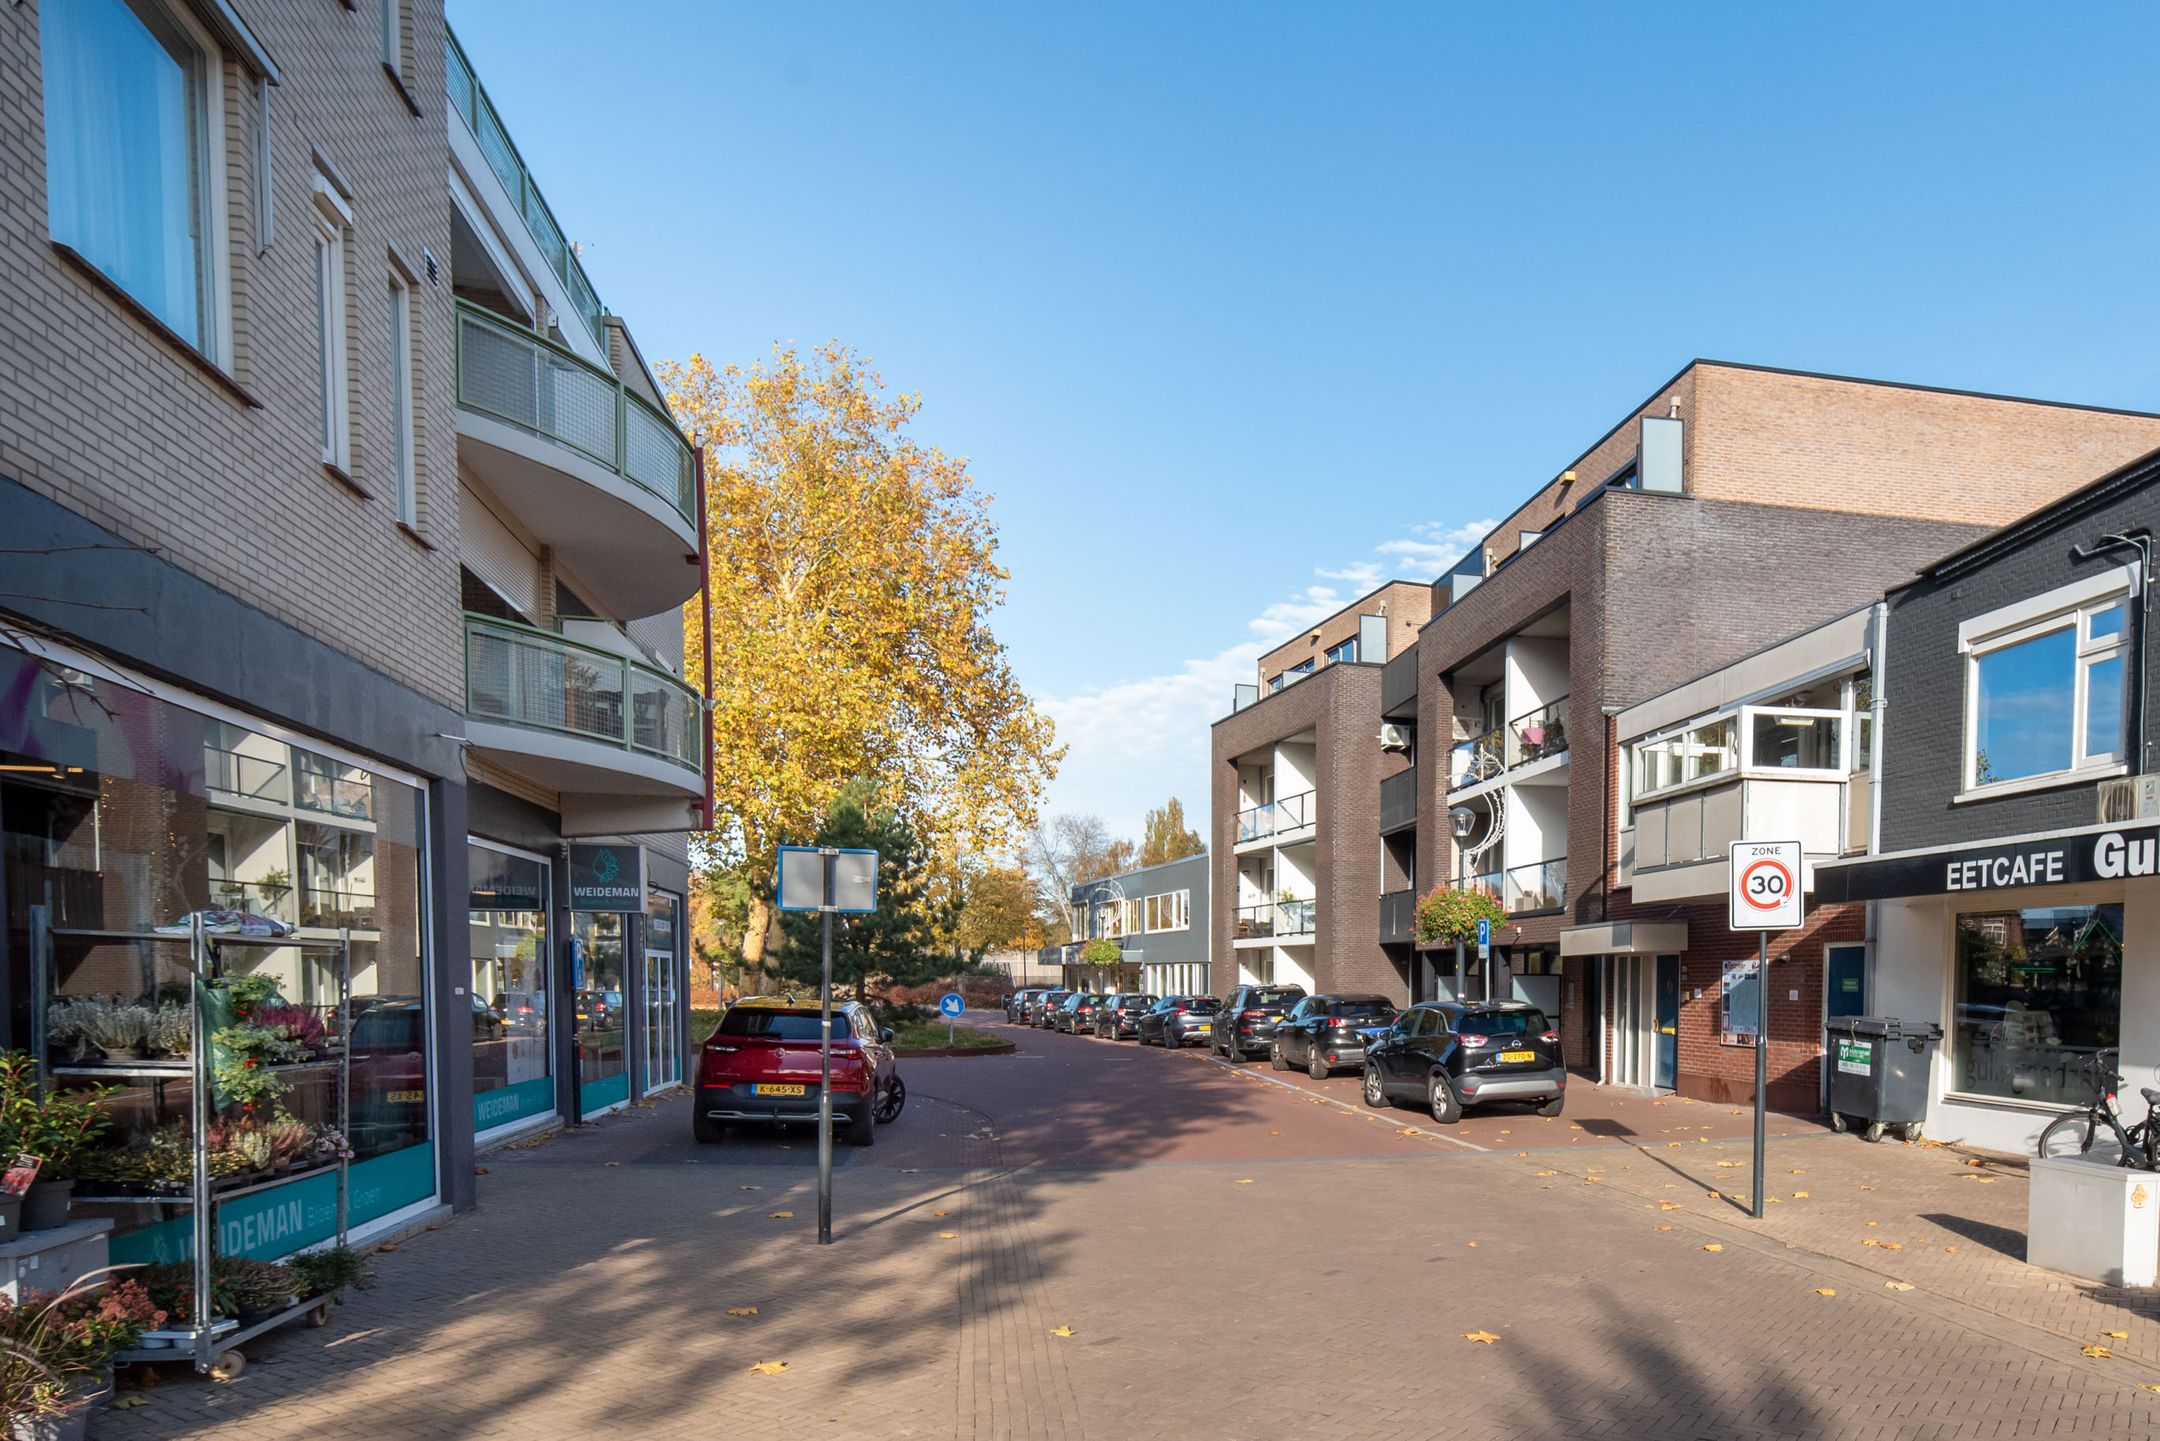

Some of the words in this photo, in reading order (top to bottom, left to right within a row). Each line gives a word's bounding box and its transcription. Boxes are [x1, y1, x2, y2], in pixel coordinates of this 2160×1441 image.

[1751, 846, 1781, 856] ZONE
[1946, 850, 2064, 890] EETCAFE
[2094, 832, 2160, 879] Gu
[573, 886, 639, 897] WEIDEMAN
[1750, 875, 1784, 894] 30
[760, 1084, 802, 1093] K-645-XS
[478, 1094, 520, 1121] WEIDEMAN
[179, 1199, 302, 1263] WIDEMAN
